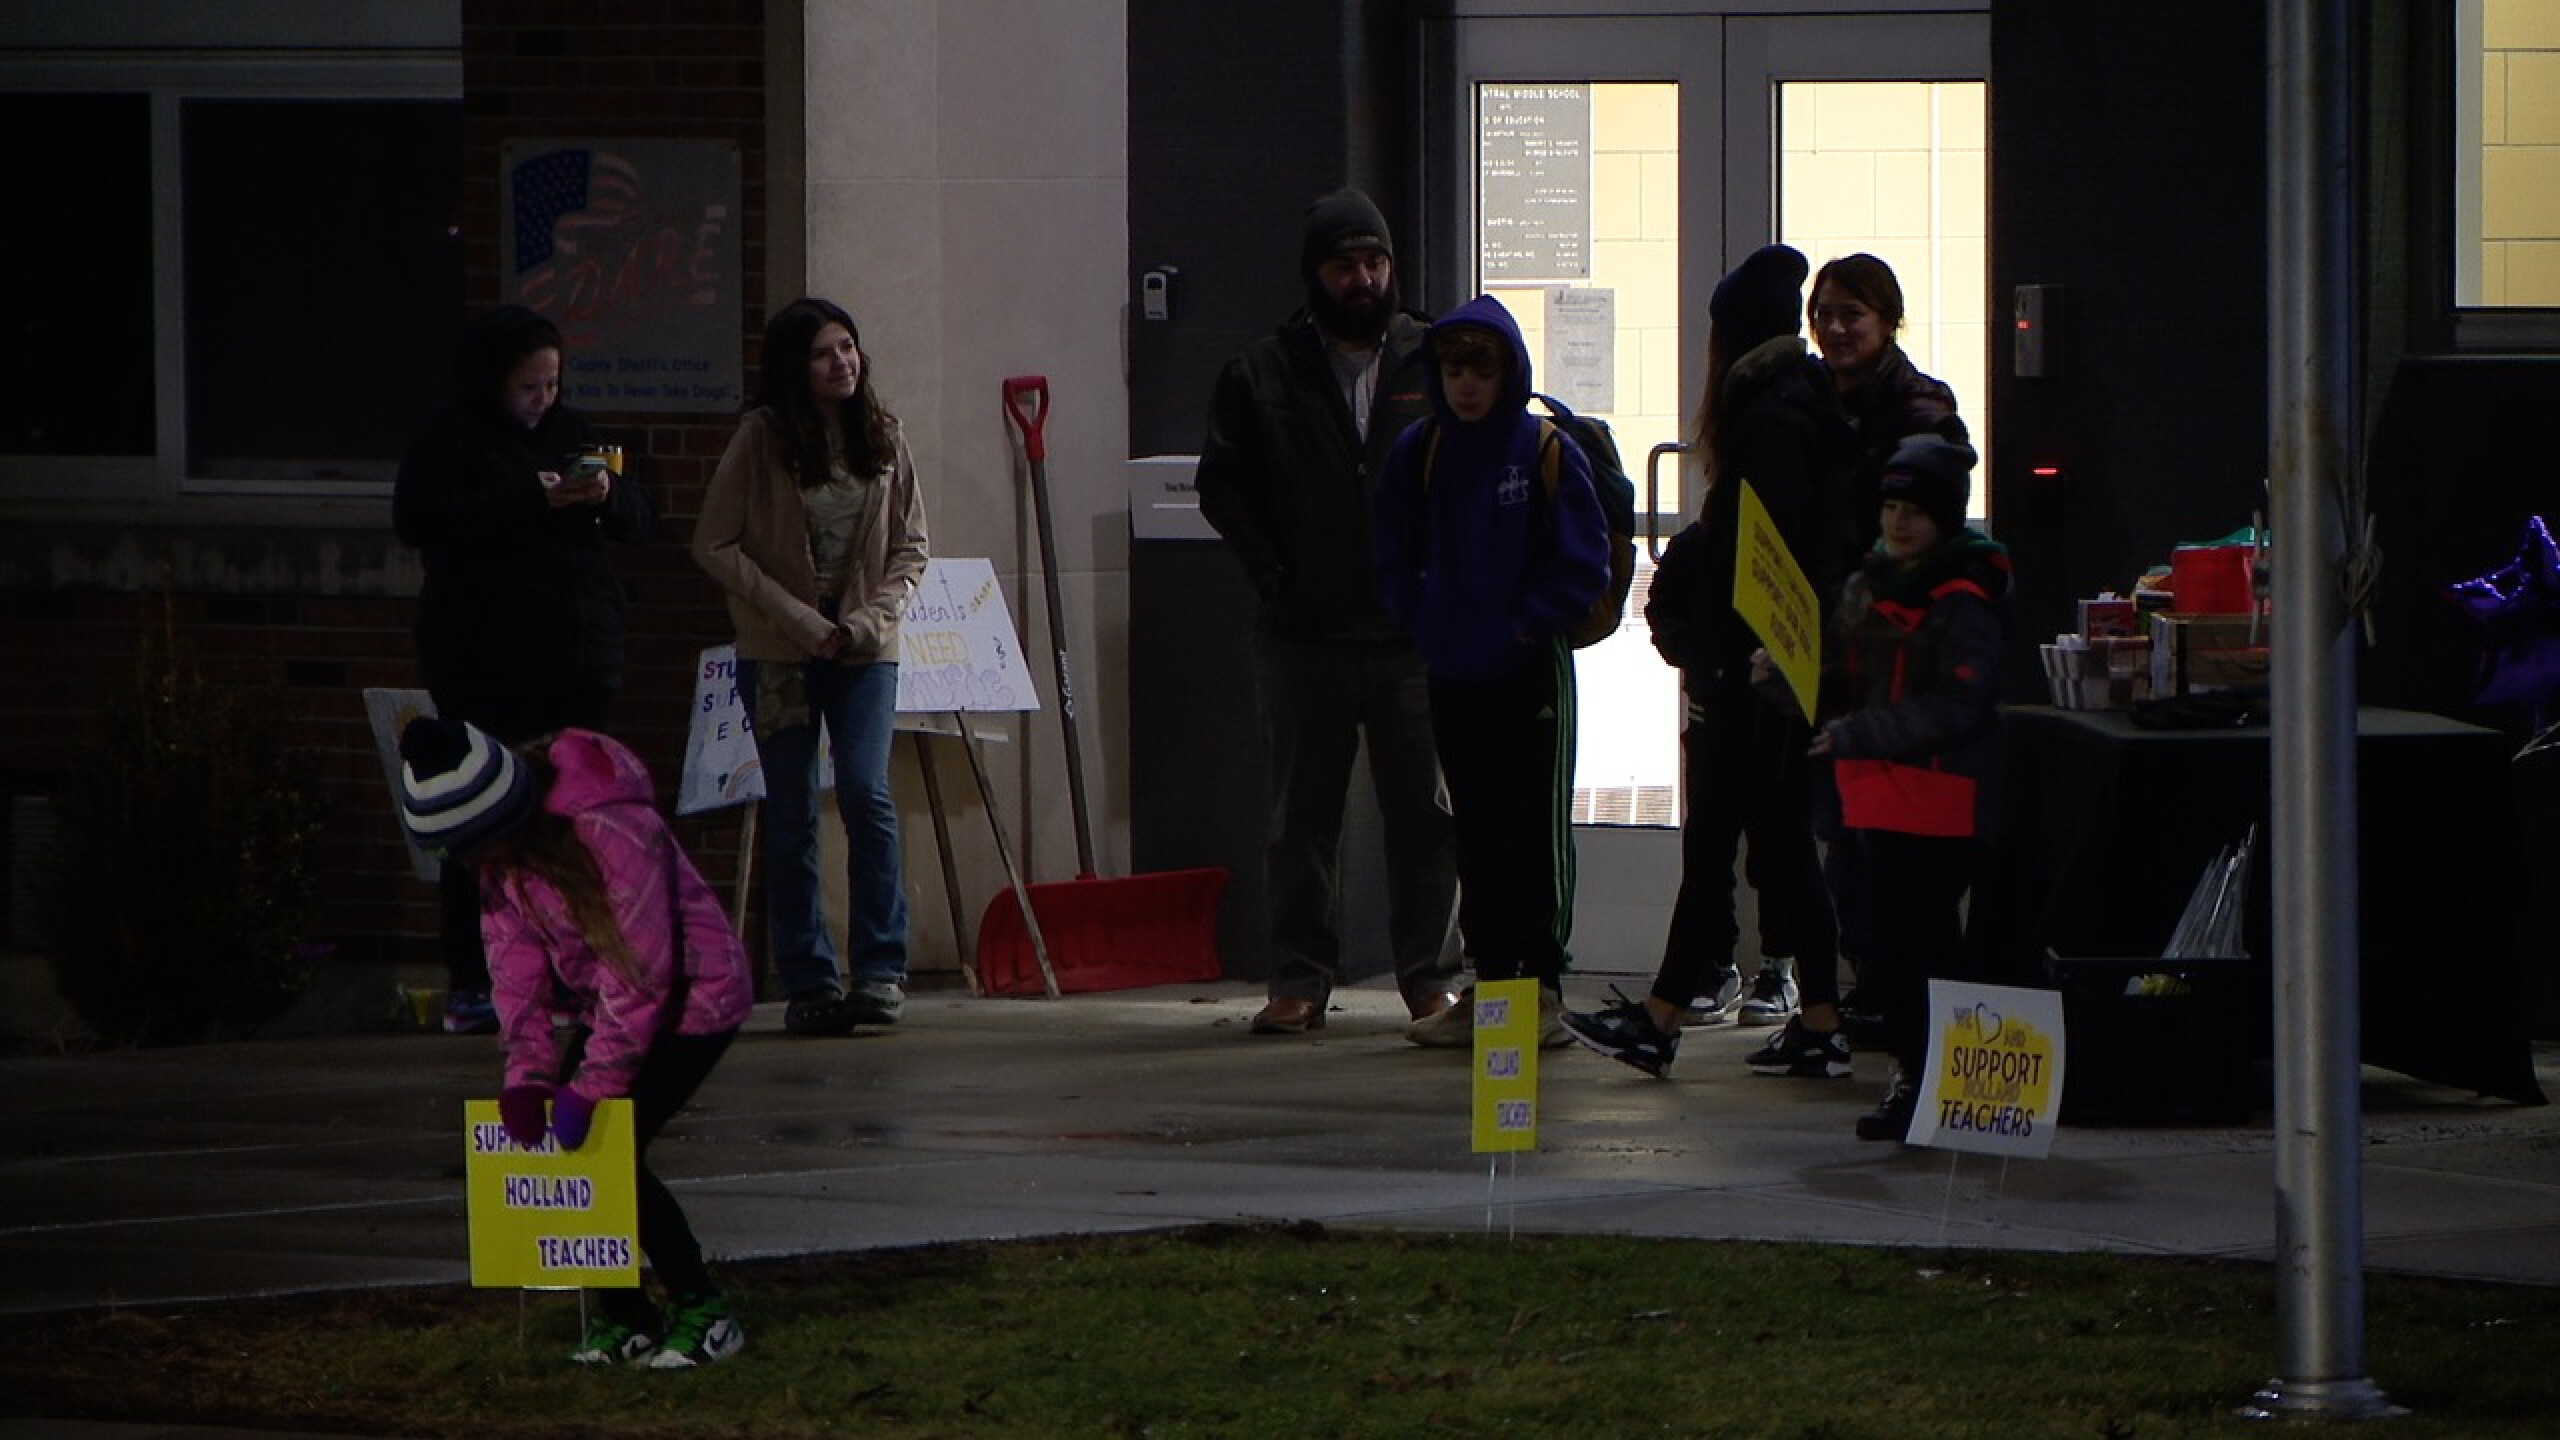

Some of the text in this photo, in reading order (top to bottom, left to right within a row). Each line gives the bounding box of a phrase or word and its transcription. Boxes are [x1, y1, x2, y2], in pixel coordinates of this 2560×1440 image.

[1513, 89, 1543, 99] MIDDLE
[1547, 89, 1580, 99] SCHOOL
[902, 631, 967, 668] NEED
[1951, 1045, 2043, 1087] SUPPORT
[1939, 1098, 2035, 1137] TEACHERS
[505, 1177, 592, 1208] HOLLAND
[537, 1238, 630, 1268] TEACHERS
